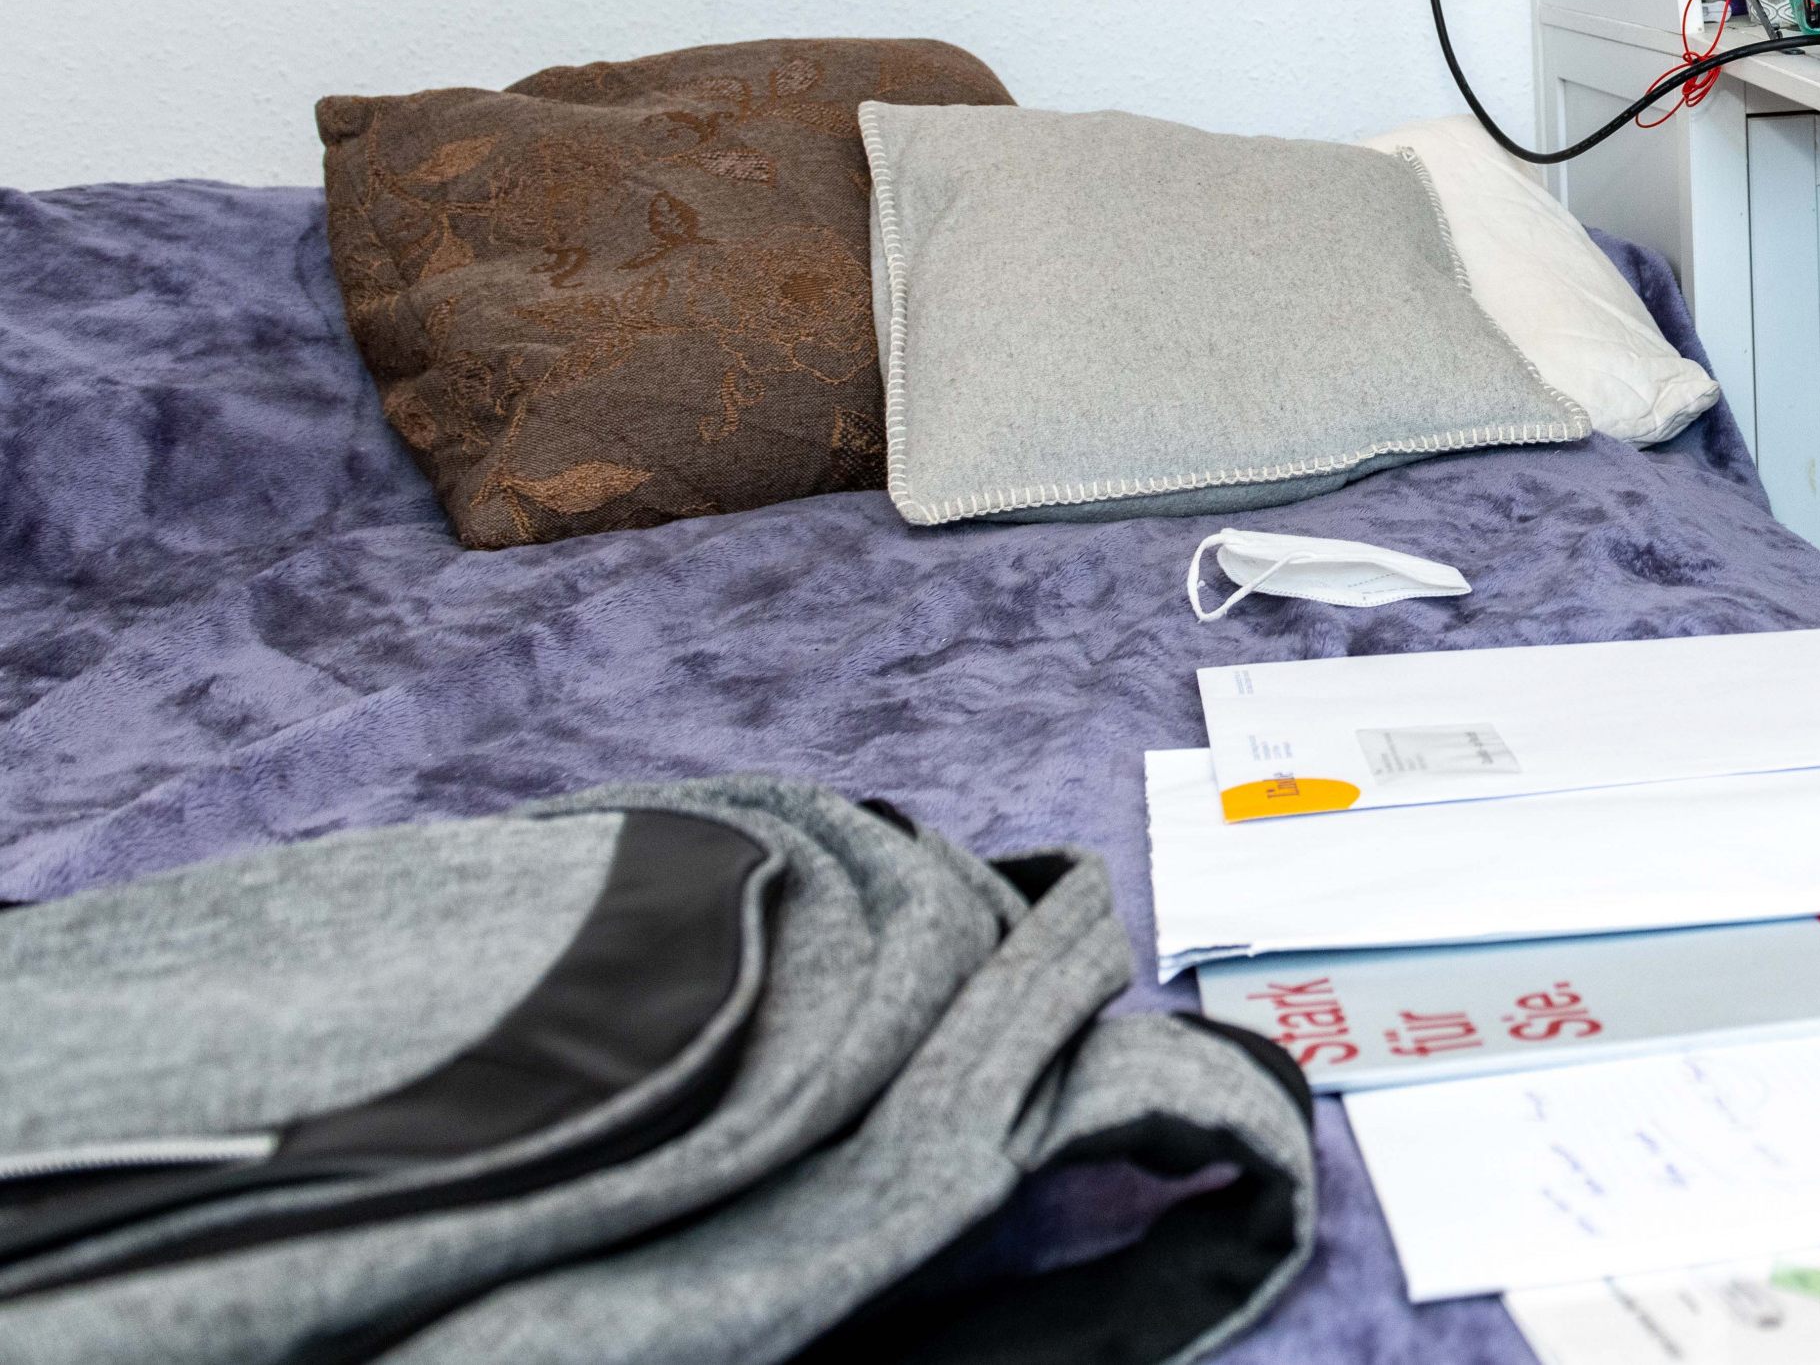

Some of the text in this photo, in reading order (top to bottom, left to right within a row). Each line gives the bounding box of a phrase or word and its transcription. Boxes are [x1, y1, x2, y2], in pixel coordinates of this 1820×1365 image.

[1245, 977, 1360, 1067] Stark
[1384, 1010, 1484, 1057] für
[1501, 980, 1604, 1042] Sie.
